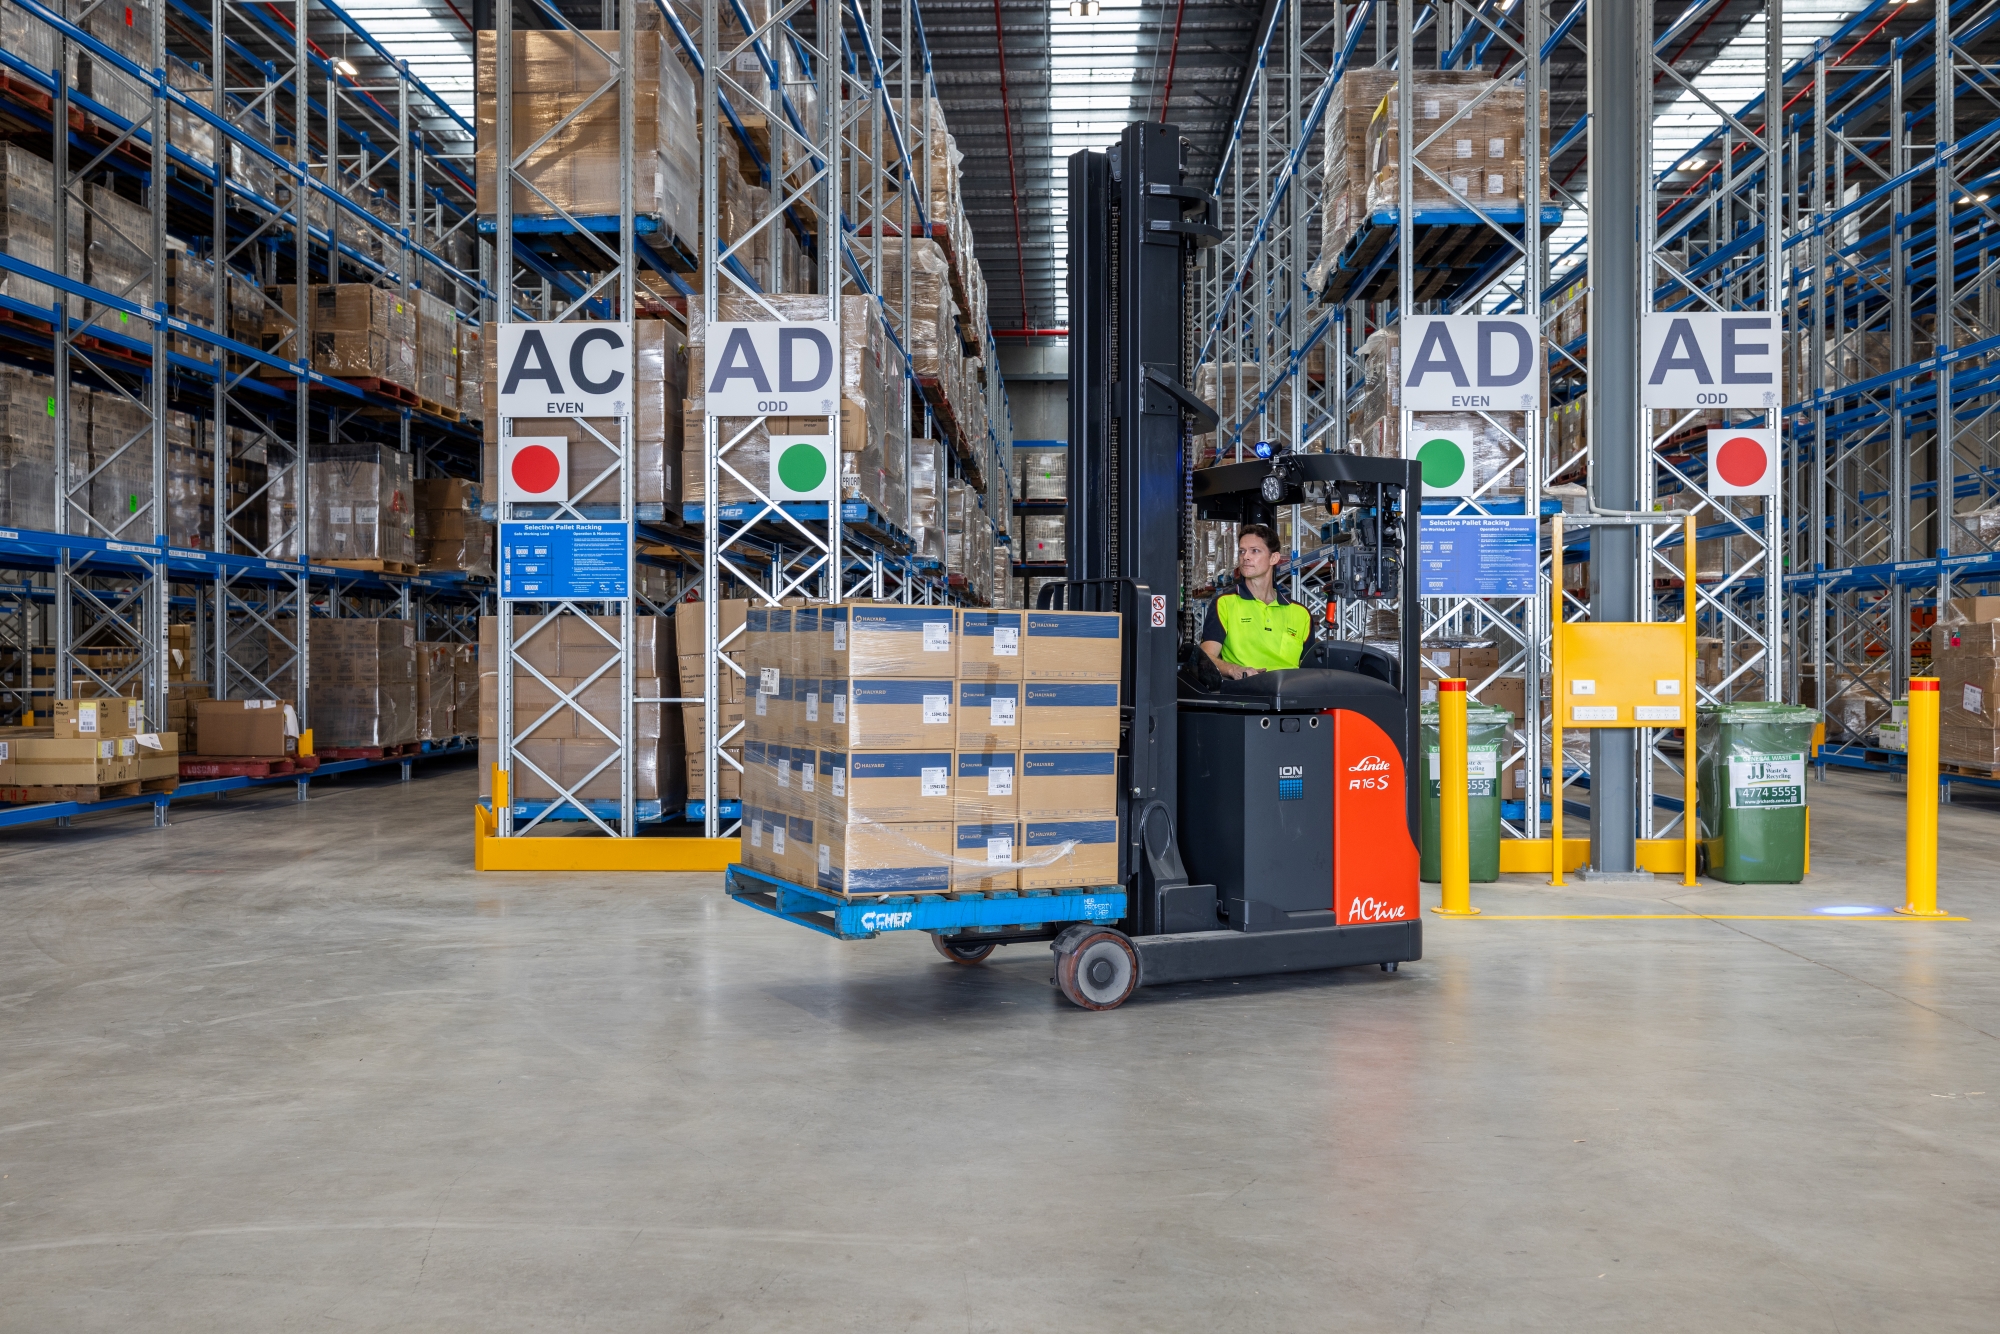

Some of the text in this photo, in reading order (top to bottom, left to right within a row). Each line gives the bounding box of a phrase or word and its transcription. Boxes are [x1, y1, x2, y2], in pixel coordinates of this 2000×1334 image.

[1405, 320, 1534, 387] AD
[1648, 318, 1773, 385] AE
[501, 327, 625, 395] AC
[708, 327, 833, 393] AD
[1452, 395, 1490, 407] EVEN
[1696, 393, 1728, 404] ODD
[547, 402, 584, 413] EVEN
[757, 401, 788, 412] ODD
[1349, 756, 1390, 772] Linde
[187, 766, 219, 774] LOSCAM
[1279, 766, 1302, 775] ION
[1743, 787, 1797, 797] 4774 5555
